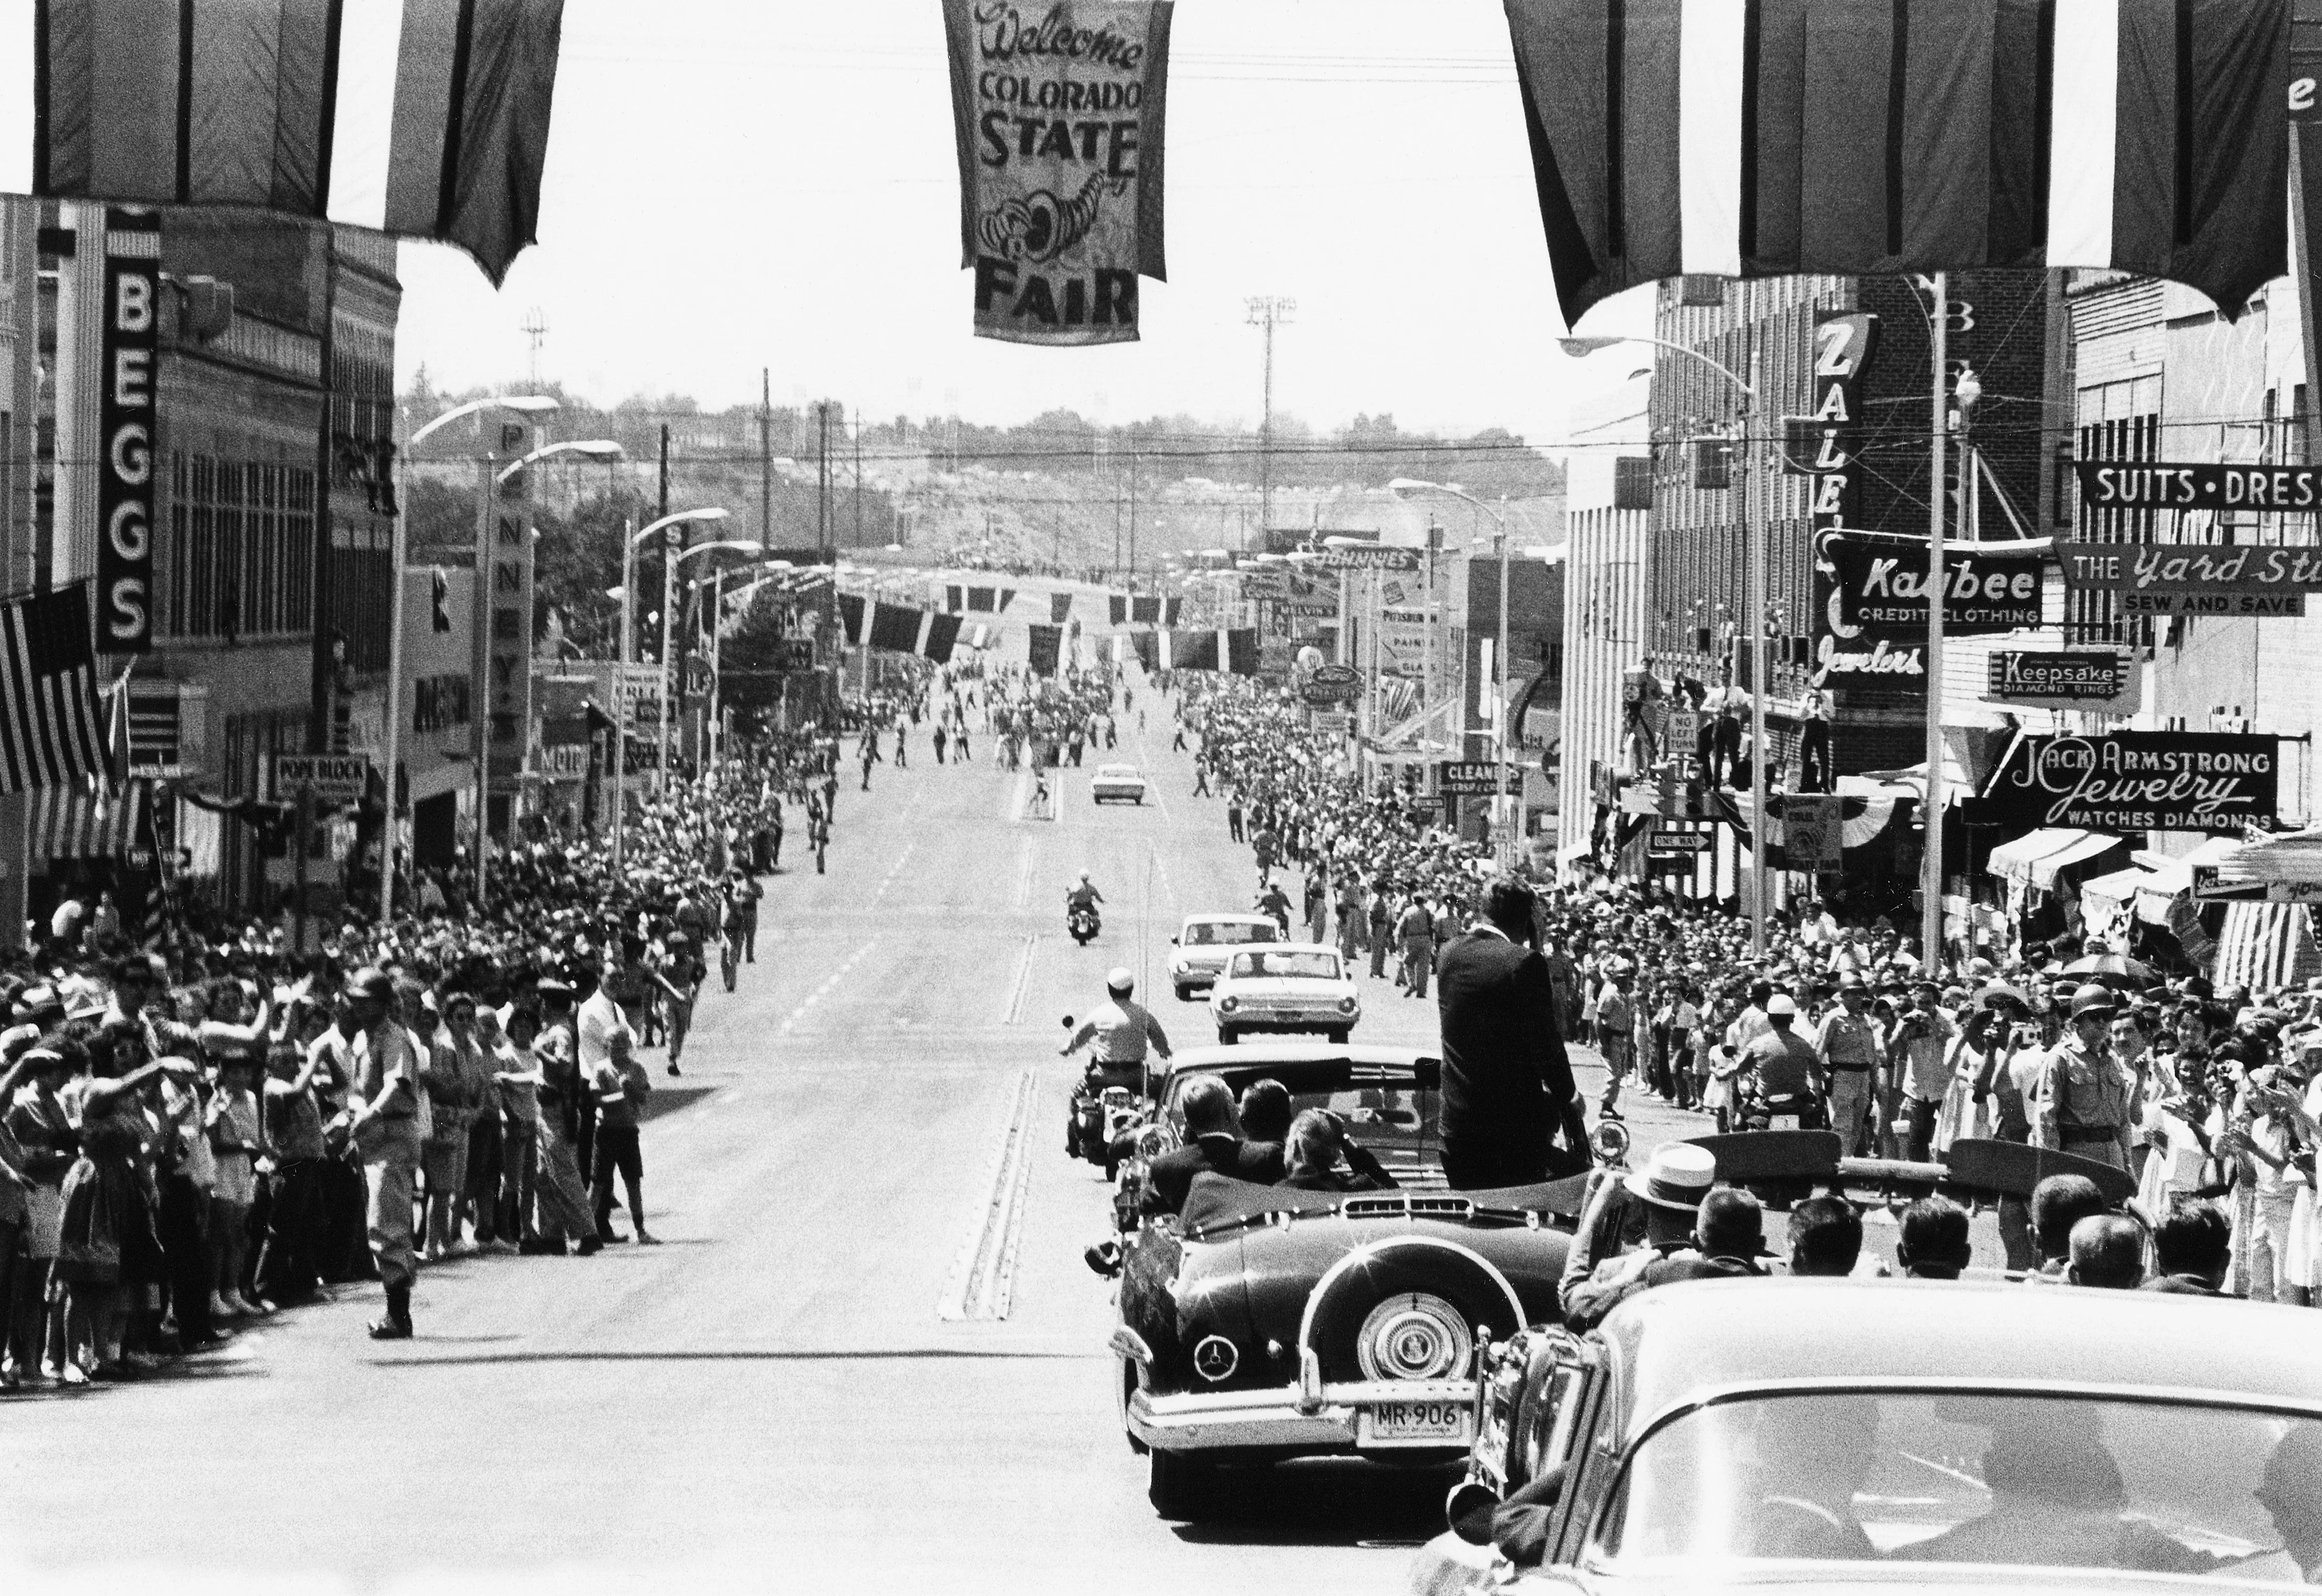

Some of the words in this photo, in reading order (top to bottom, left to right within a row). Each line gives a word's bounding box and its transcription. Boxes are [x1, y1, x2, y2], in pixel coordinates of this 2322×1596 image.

[974, 0, 1143, 70] Welcome
[979, 71, 1142, 109] COLORADO
[980, 109, 1138, 178] STATE
[975, 255, 1137, 325] FAIR
[109, 272, 153, 639] BEGGS
[2096, 468, 2196, 504] SUITS
[2225, 471, 2322, 506] DRES
[2073, 556, 2120, 580] THE
[2133, 546, 2250, 588] Yard
[1383, 610, 1438, 623] PITTSBURH
[1857, 607, 1928, 622] CREDIT
[1941, 608, 2039, 623] CLOTHING
[2125, 594, 2173, 611] SEW
[2182, 595, 2229, 612] AND
[2240, 595, 2298, 613] SAVE
[1811, 635, 1924, 688] Jewelers
[2005, 652, 2114, 685] Keepsake
[2003, 684, 2065, 694] DIAMOND
[2074, 685, 2115, 695] RINGS
[1671, 729, 1695, 738] LEFT
[1675, 717, 1691, 727] NO
[1671, 739, 1696, 749] TURN
[2012, 738, 2094, 787] JACK
[2102, 740, 2270, 777] ARMSTRONG
[2038, 736, 2256, 824] Jewelry
[2068, 811, 2155, 828] WATCHES
[2164, 812, 2272, 830] DIAMONDS
[1656, 836, 1674, 846] ONE
[1679, 836, 1697, 846] WAY
